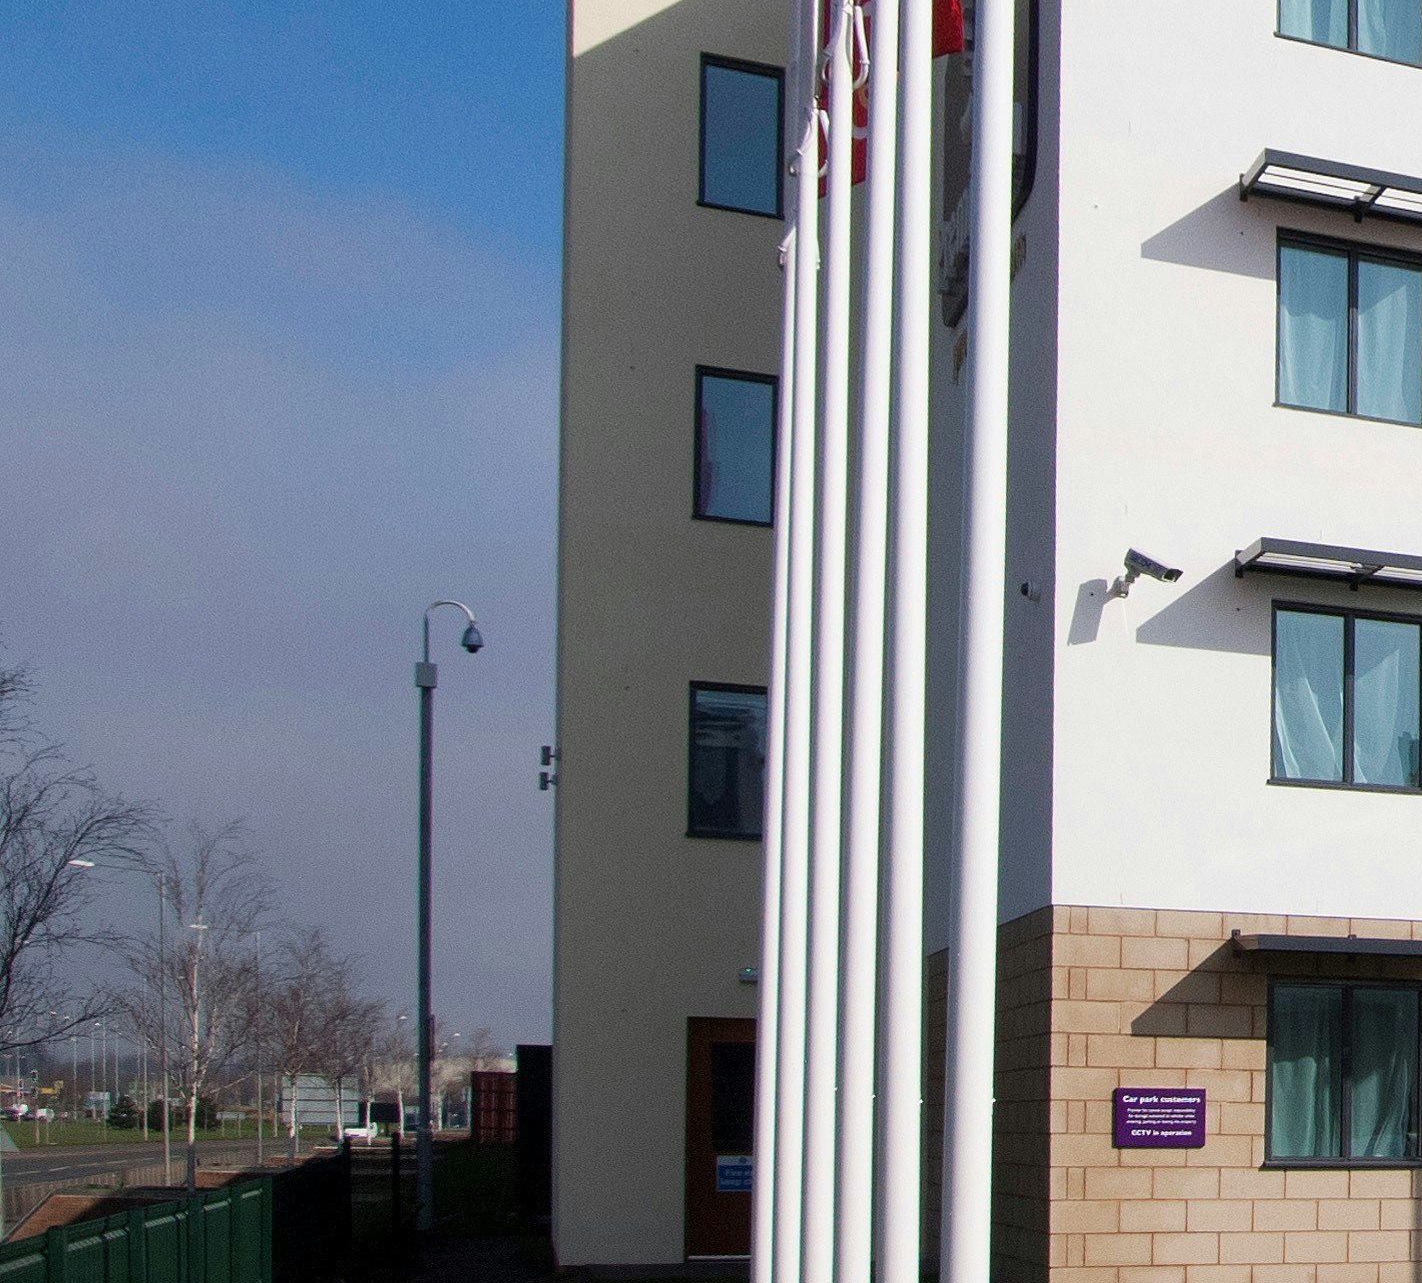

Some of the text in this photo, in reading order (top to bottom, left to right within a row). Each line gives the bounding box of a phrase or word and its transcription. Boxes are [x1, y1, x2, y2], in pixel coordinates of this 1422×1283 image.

[1122, 1095, 1201, 1104] Car park customers
